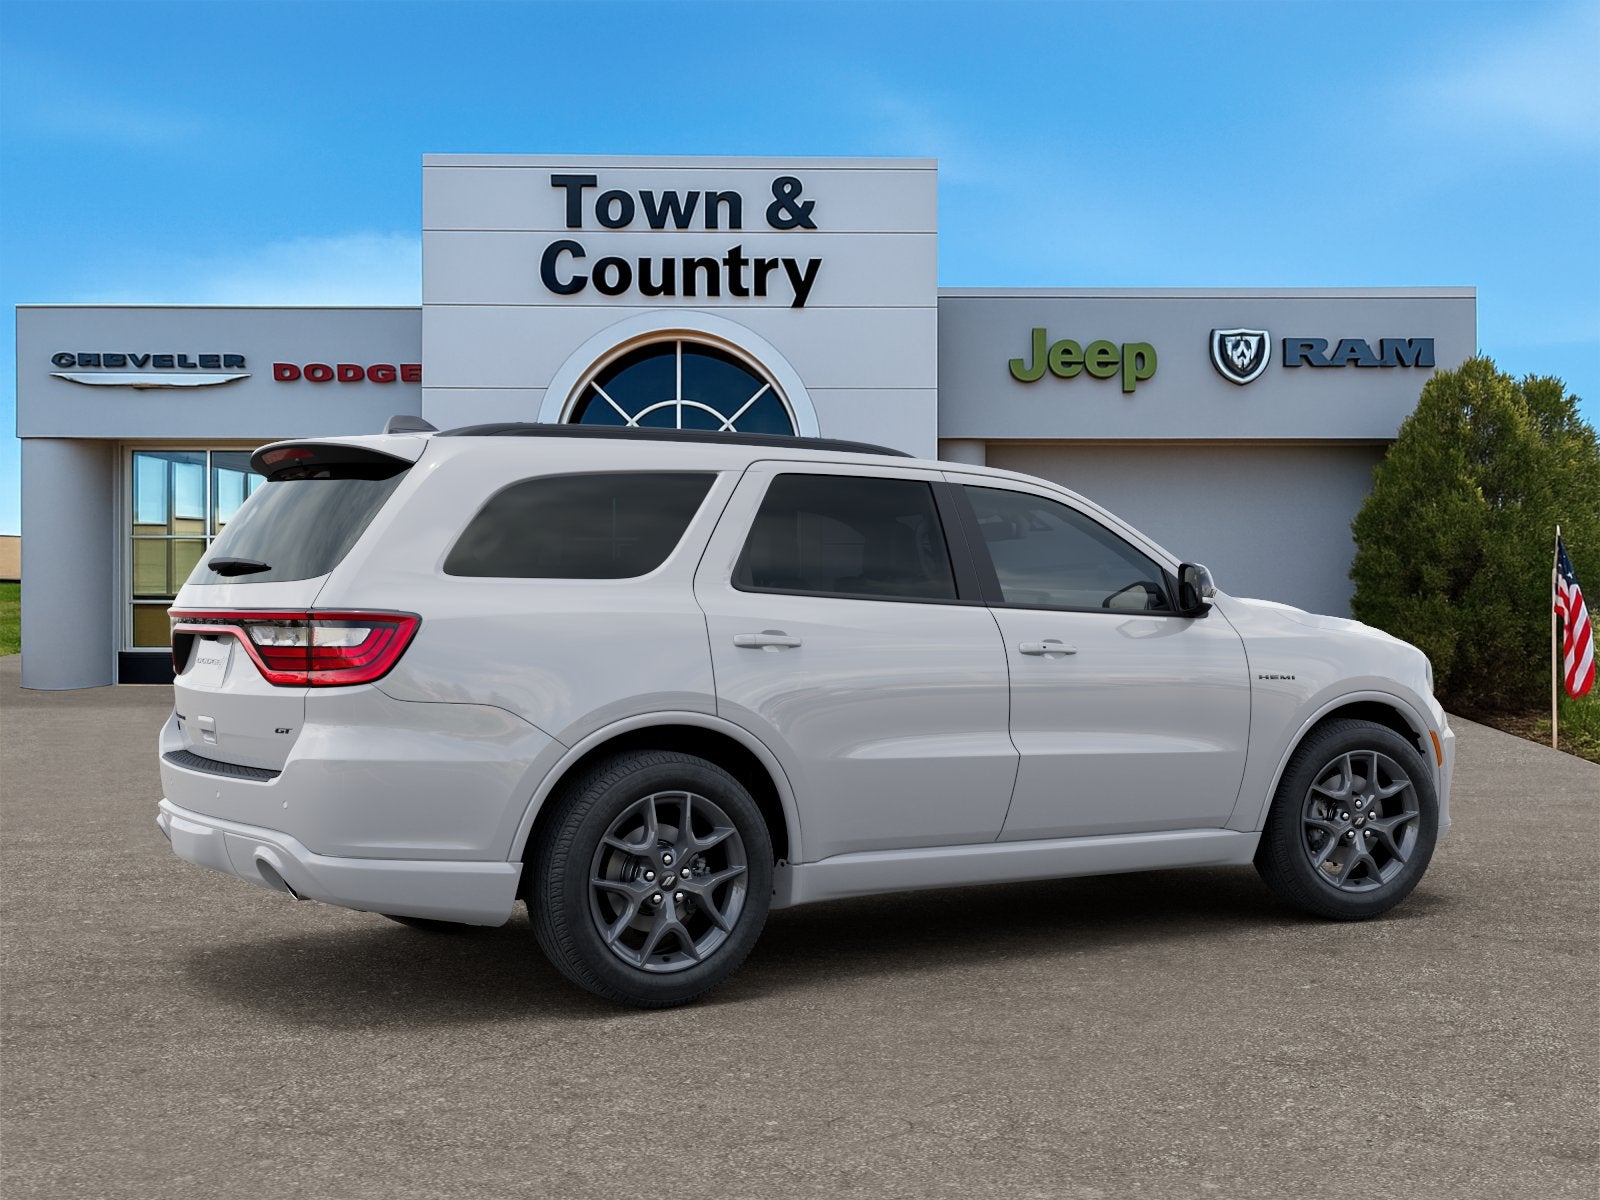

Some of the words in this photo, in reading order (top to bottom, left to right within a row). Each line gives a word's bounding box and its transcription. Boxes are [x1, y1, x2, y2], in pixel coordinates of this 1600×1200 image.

[550, 174, 742, 229] Town
[766, 176, 818, 229] &
[540, 239, 822, 308] Country
[273, 363, 422, 383] DODGE
[1009, 328, 1157, 393] Jeep
[1283, 338, 1435, 367] RAM
[274, 727, 293, 735] GT
